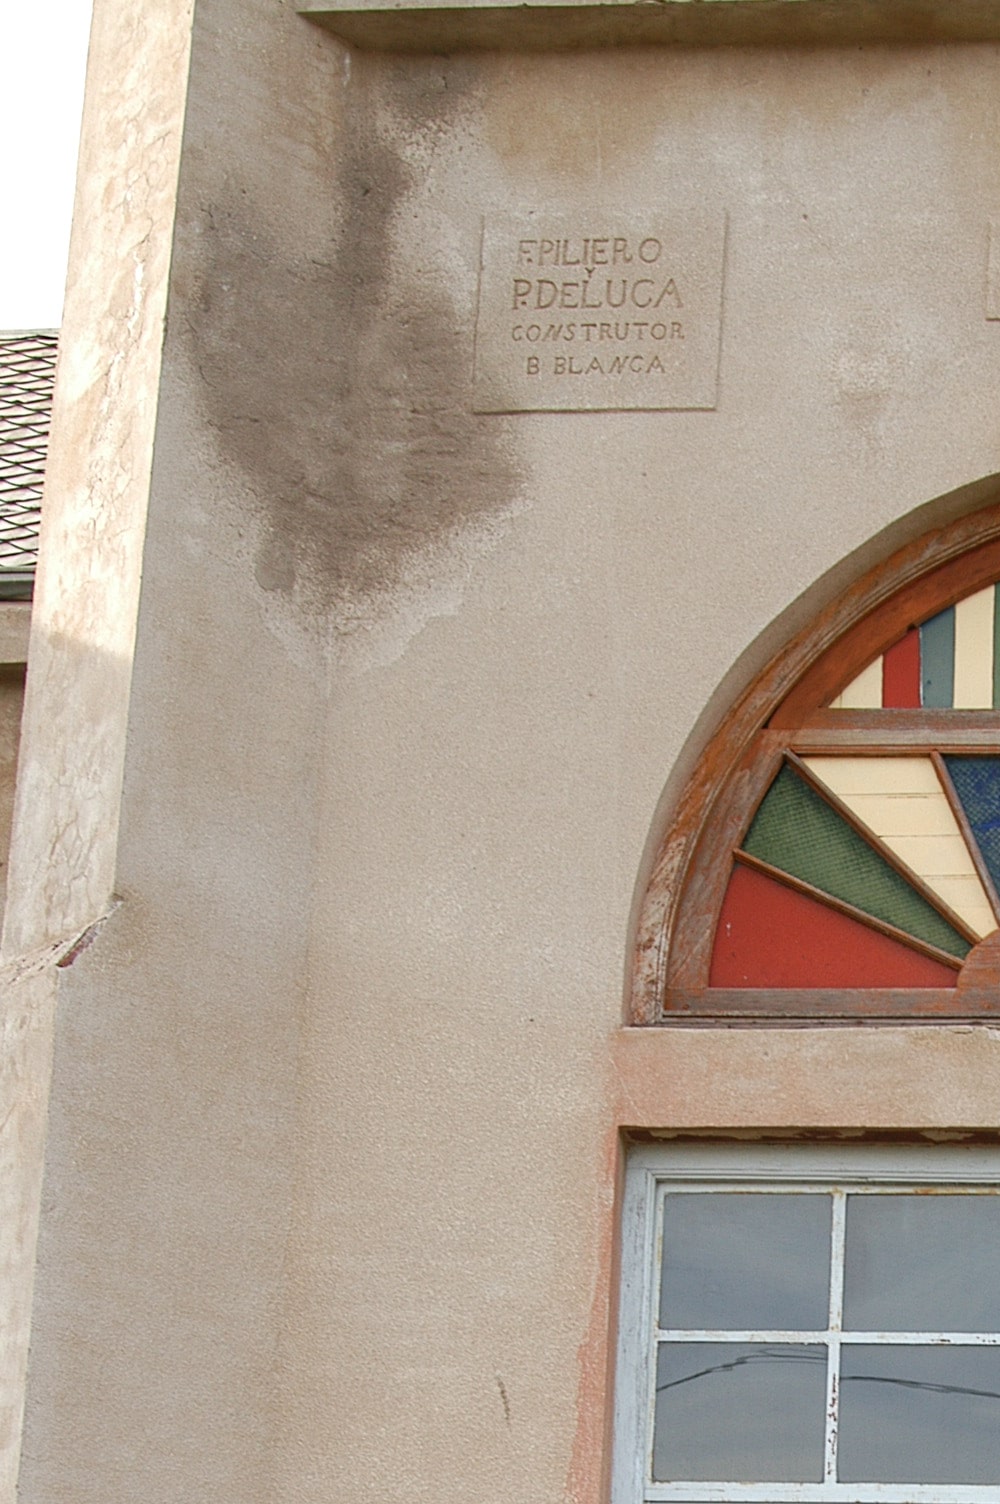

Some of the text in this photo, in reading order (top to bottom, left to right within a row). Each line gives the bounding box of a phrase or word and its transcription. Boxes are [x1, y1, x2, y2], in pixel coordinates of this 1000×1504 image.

[511, 322, 685, 342] CONSTRUTOR
[526, 356, 666, 375] B BLANCA
